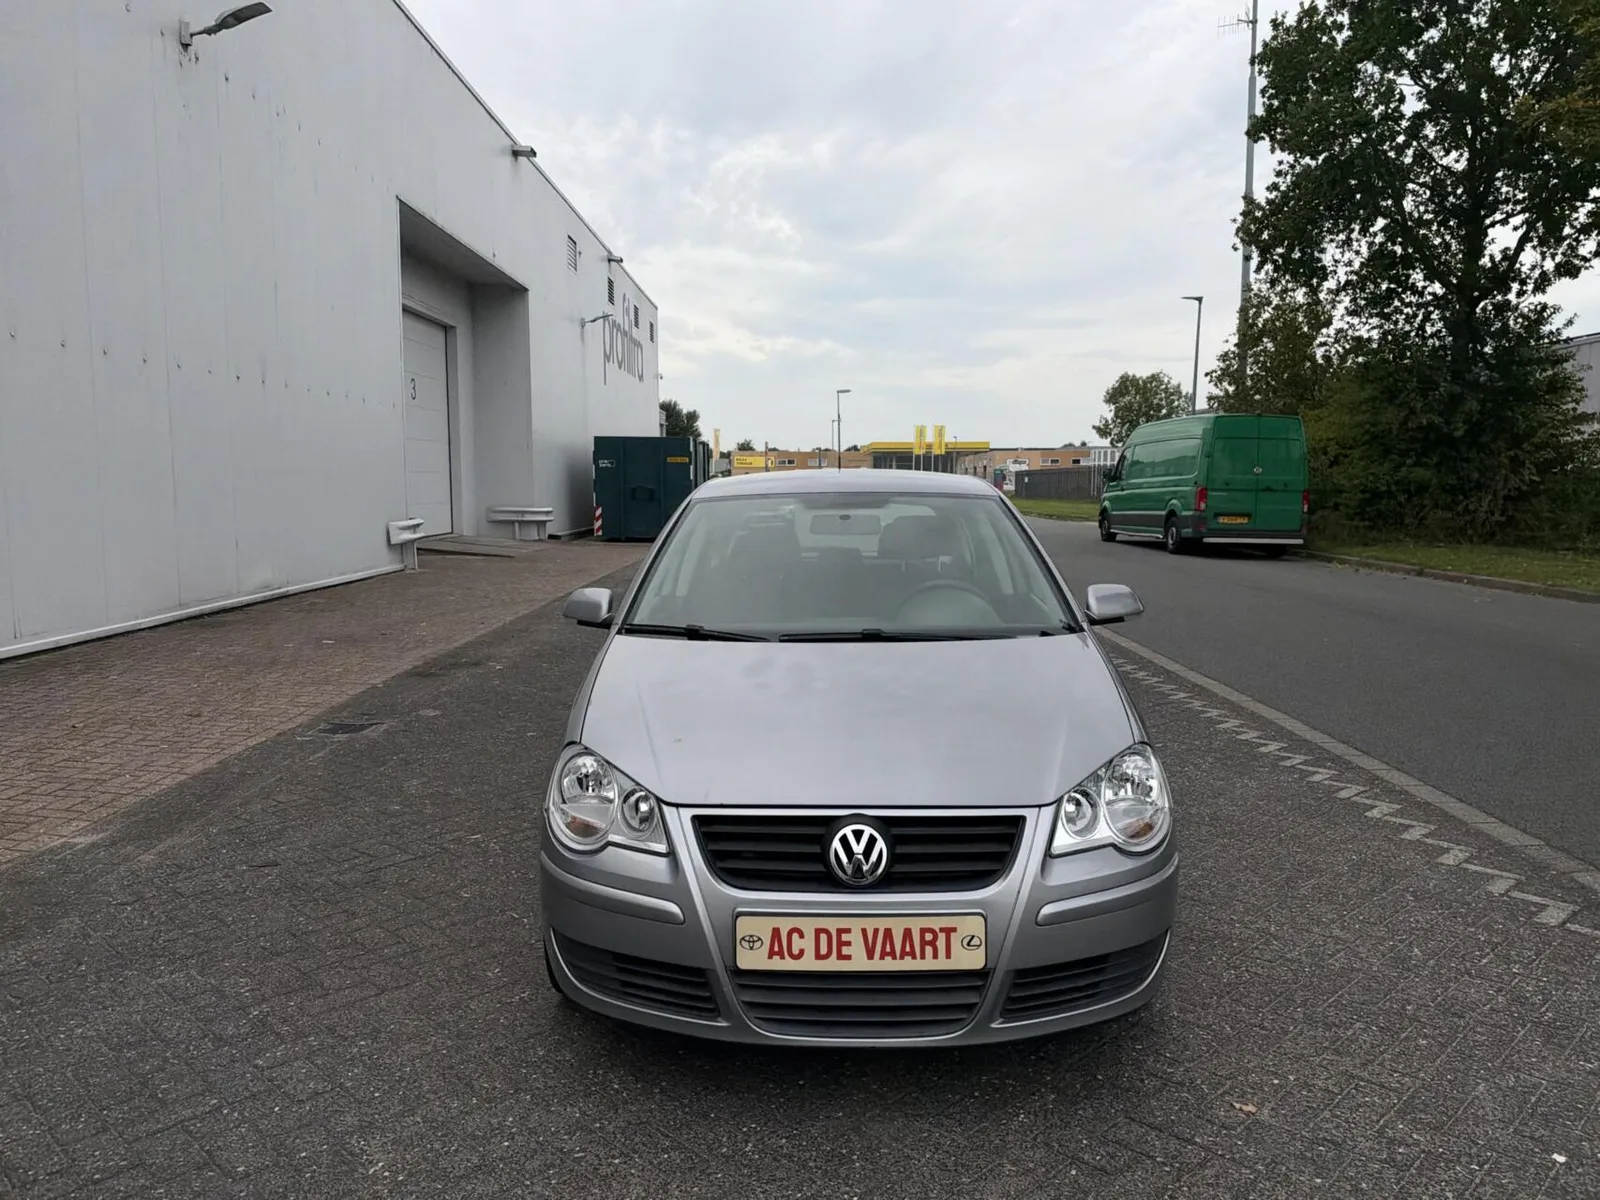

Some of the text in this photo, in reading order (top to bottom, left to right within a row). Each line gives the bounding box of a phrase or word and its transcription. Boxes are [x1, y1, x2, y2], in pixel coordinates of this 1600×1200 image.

[410, 377, 416, 400] 3
[767, 926, 957, 961] AC DE VAART
